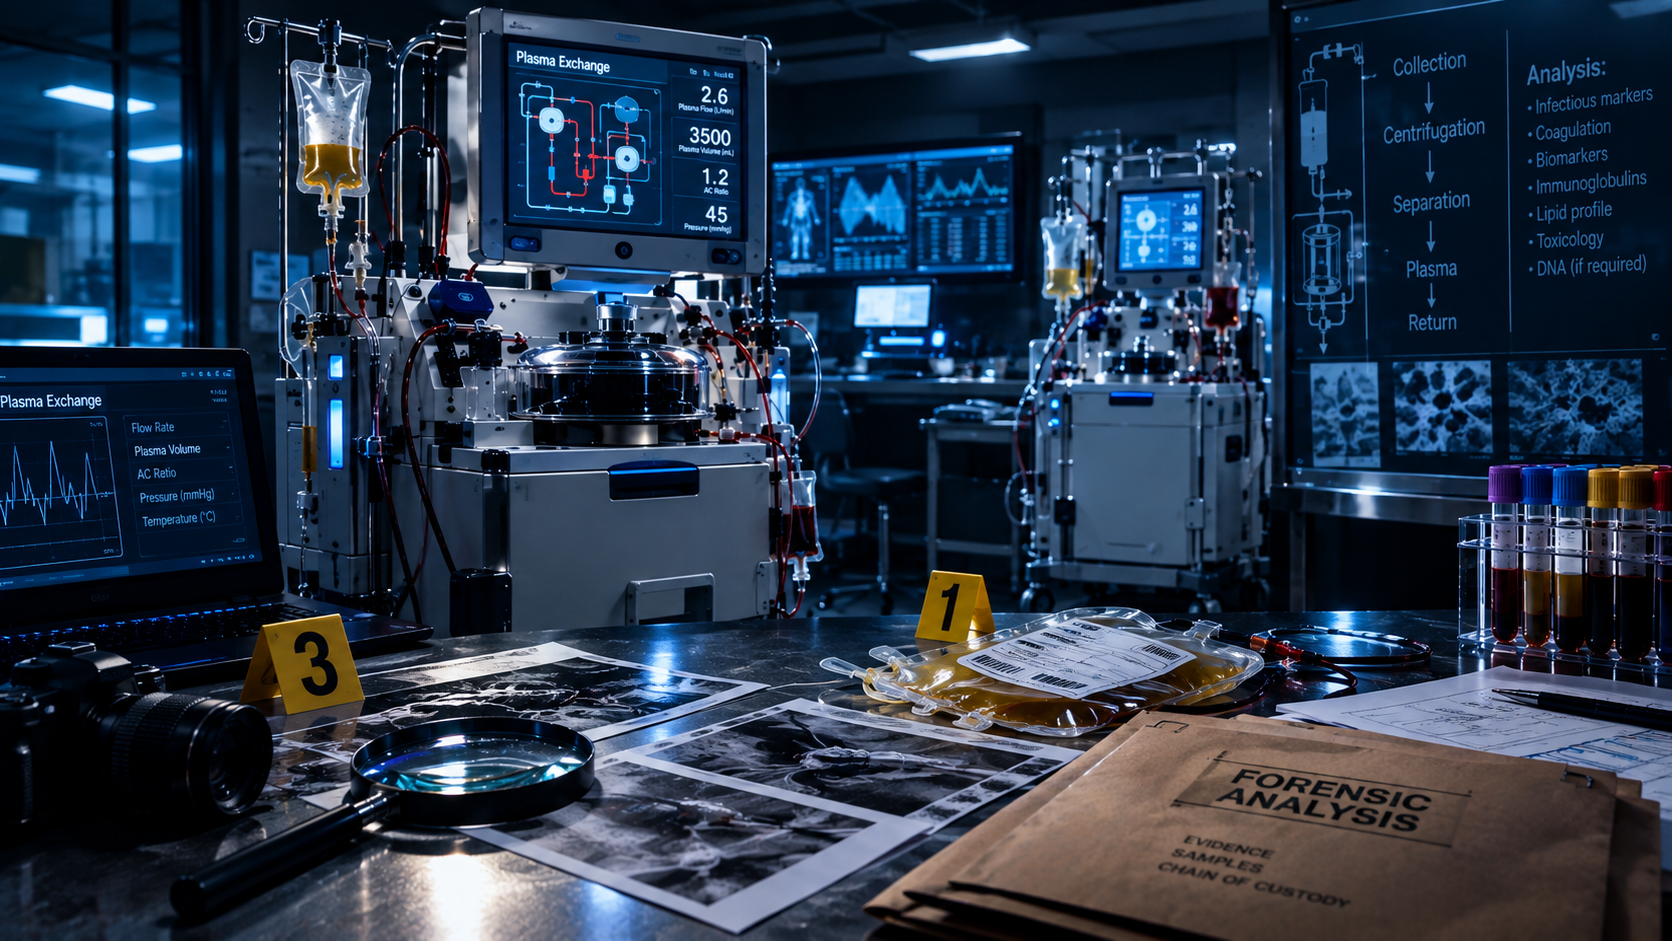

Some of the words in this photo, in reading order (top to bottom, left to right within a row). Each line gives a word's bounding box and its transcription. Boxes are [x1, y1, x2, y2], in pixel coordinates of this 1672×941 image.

[516, 50, 556, 67] Plasma
[559, 55, 611, 75] Exchange
[1393, 51, 1467, 77] Collection
[1526, 57, 1606, 86] Analysis:
[678, 102, 700, 112] Plasma
[701, 85, 729, 105] 2.6
[1535, 94, 1597, 115] Infectious
[1601, 86, 1654, 107] markers
[689, 126, 732, 147] 3500
[1383, 117, 1486, 145] Centrifugation
[1535, 119, 1612, 143] Coagulation
[678, 144, 700, 154] Plasma
[1536, 146, 1609, 168] Biomarkers
[702, 167, 729, 186] 1.2
[1536, 169, 1648, 195] Immunoglobulins
[704, 205, 728, 224] 45
[1393, 190, 1471, 217] Separation
[1536, 203, 1567, 225] Lipid
[1570, 200, 1613, 223] profile
[1536, 229, 1605, 250] Toxicology
[1406, 259, 1458, 279] Plasma
[1537, 259, 1567, 277] DNA
[1570, 257, 1584, 278] (if
[1587, 253, 1647, 278] required)
[1408, 313, 1457, 331] Return
[0, 394, 43, 409] Plasma
[46, 393, 102, 410] Exchange
[131, 422, 153, 434] Flow
[154, 421, 175, 433] Rate
[134, 445, 167, 457] Plasma
[168, 443, 201, 455] Volume
[137, 468, 152, 480] AC
[139, 492, 178, 504] Pressure
[180, 487, 215, 503] (mmHg)
[142, 513, 198, 528] Temperature
[940, 583, 960, 632] 1
[293, 631, 339, 697] 3
[1230, 768, 1433, 812] FORENSIC
[1216, 787, 1421, 833] ANALYSIS
[1183, 835, 1275, 860] EVIDENCE
[1170, 848, 1265, 875] SAMPLES
[1157, 861, 1220, 882] CHAIN
[1222, 874, 1252, 888] OF
[1253, 880, 1352, 909] CUSTODY
